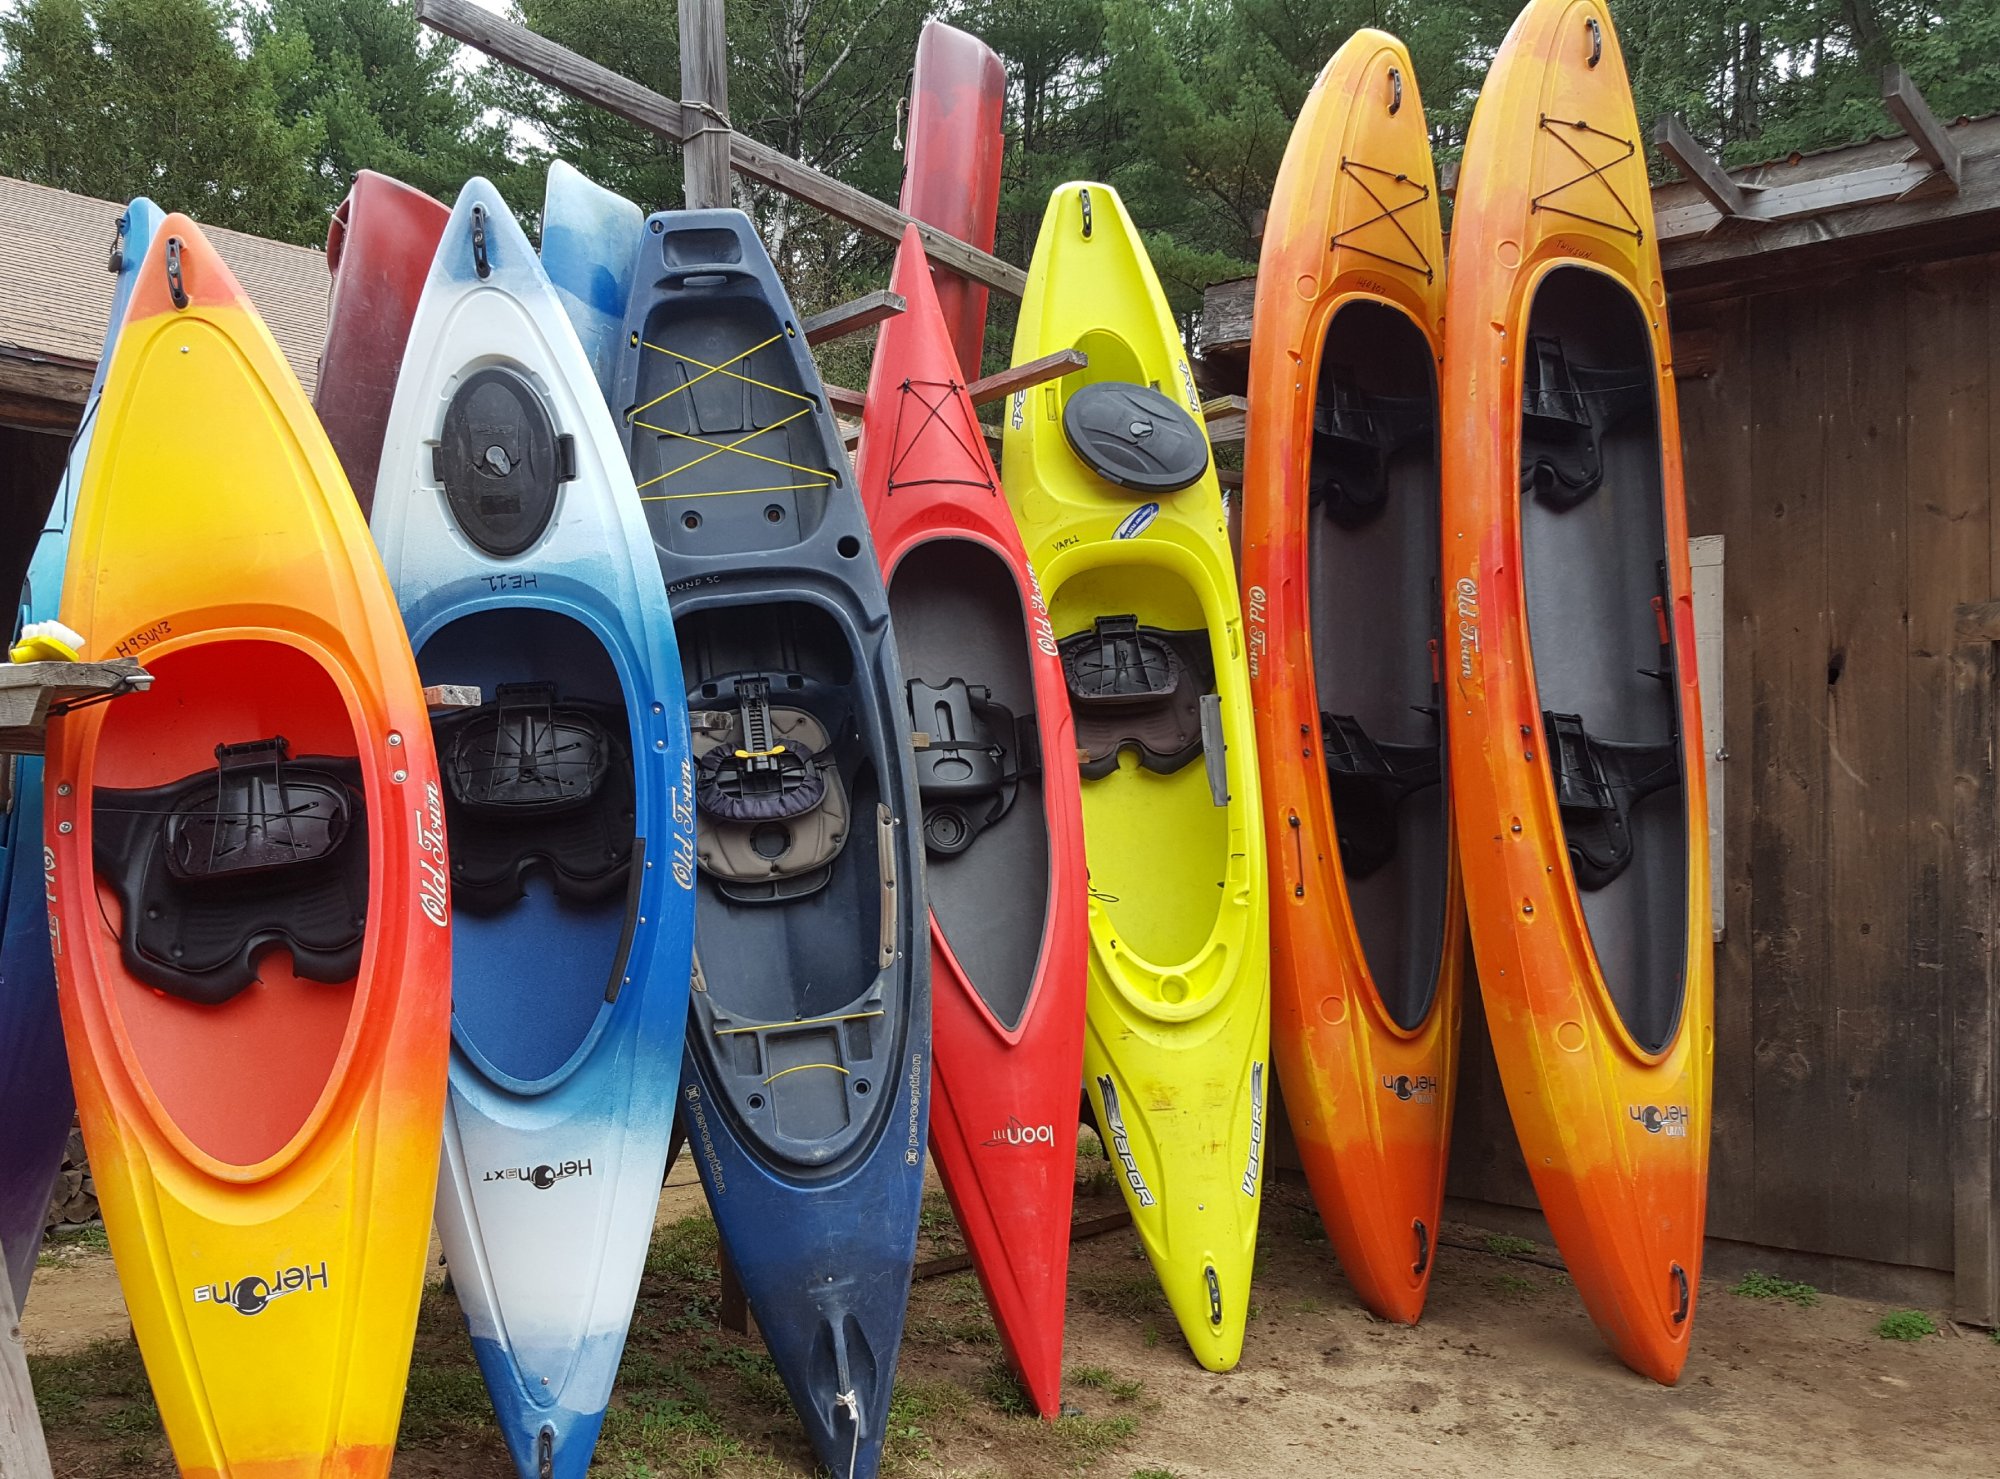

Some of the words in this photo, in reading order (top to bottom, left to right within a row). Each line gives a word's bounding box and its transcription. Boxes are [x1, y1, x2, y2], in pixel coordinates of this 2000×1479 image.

[1025, 560, 1048, 616] Town
[1248, 585, 1267, 623] Old
[1456, 577, 1478, 619] Old
[1034, 616, 1059, 656] Old
[1248, 625, 1266, 679] Town
[1458, 620, 1480, 679] Town
[415, 780, 446, 865] Town
[671, 757, 694, 834] Town
[671, 832, 694, 890] Old
[419, 859, 448, 927] Old
[909, 1053, 922, 1147] perception
[1629, 1104, 1689, 1134] Heron
[690, 1102, 727, 1196] perception
[1007, 1124, 1055, 1148] loon
